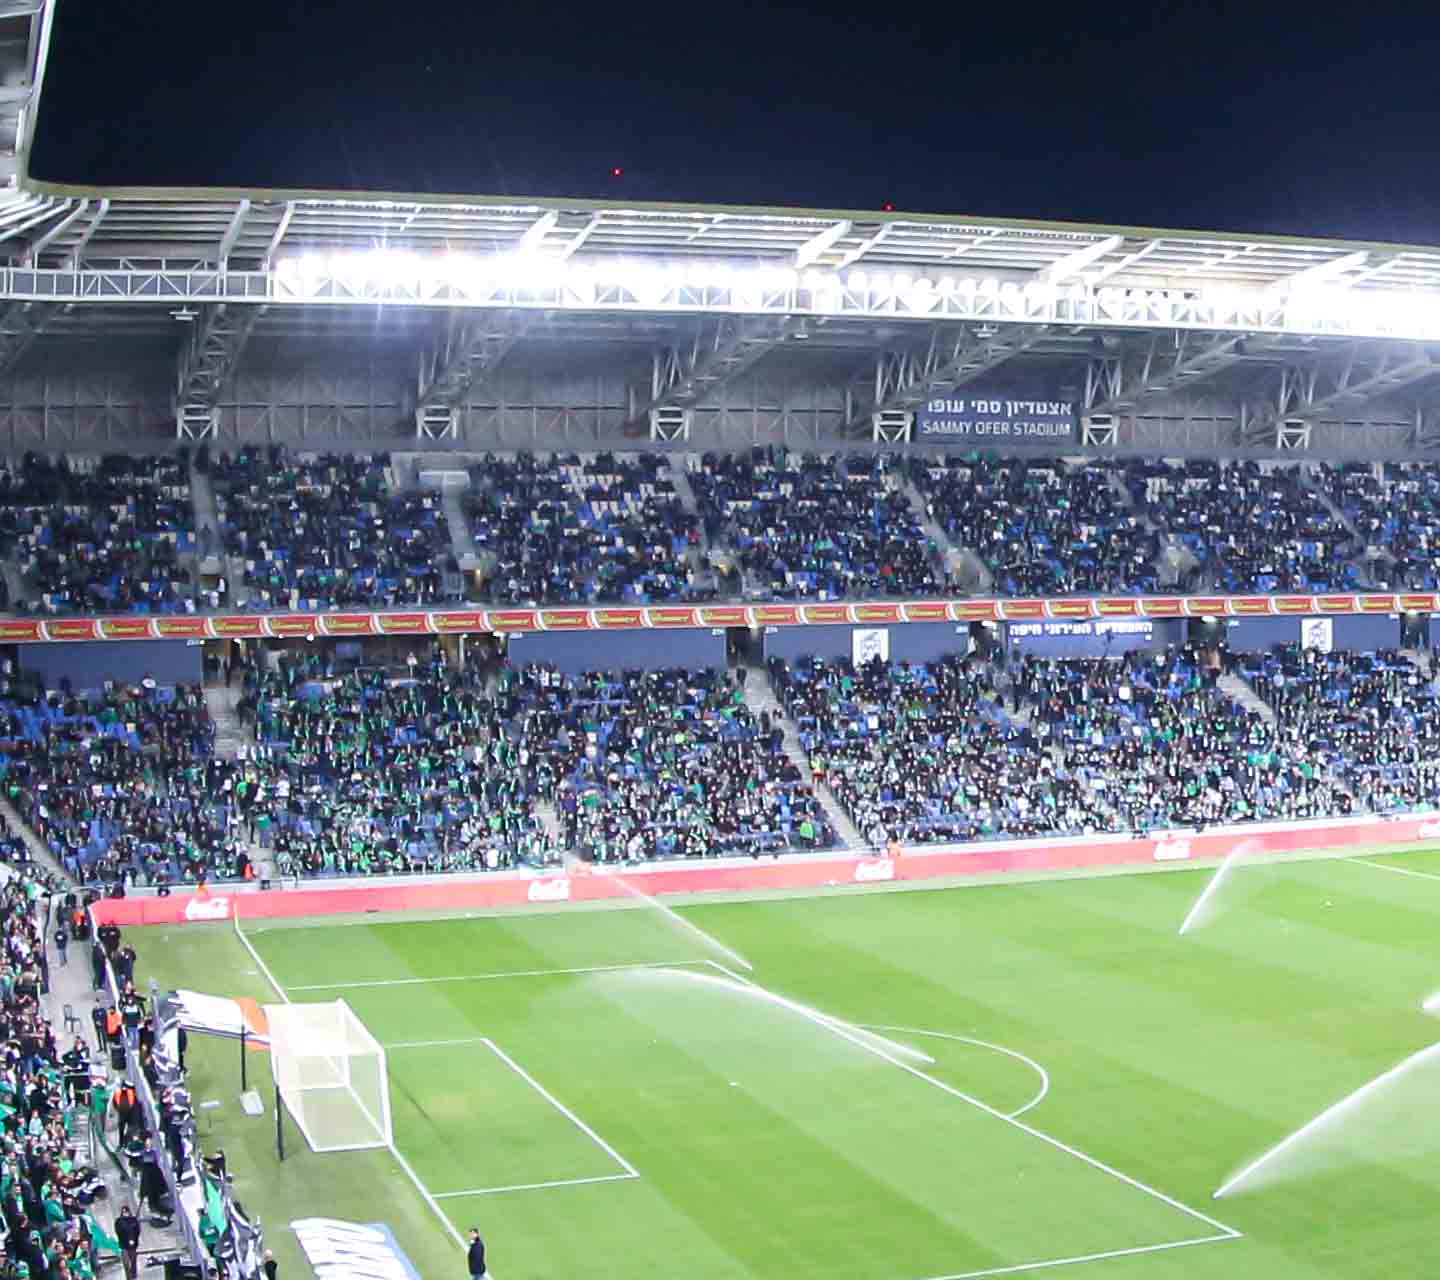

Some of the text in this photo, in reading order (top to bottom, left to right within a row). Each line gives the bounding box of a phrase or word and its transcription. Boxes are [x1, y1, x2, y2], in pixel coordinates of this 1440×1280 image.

[922, 421, 1071, 436] SAMMY OFER STADIUM
